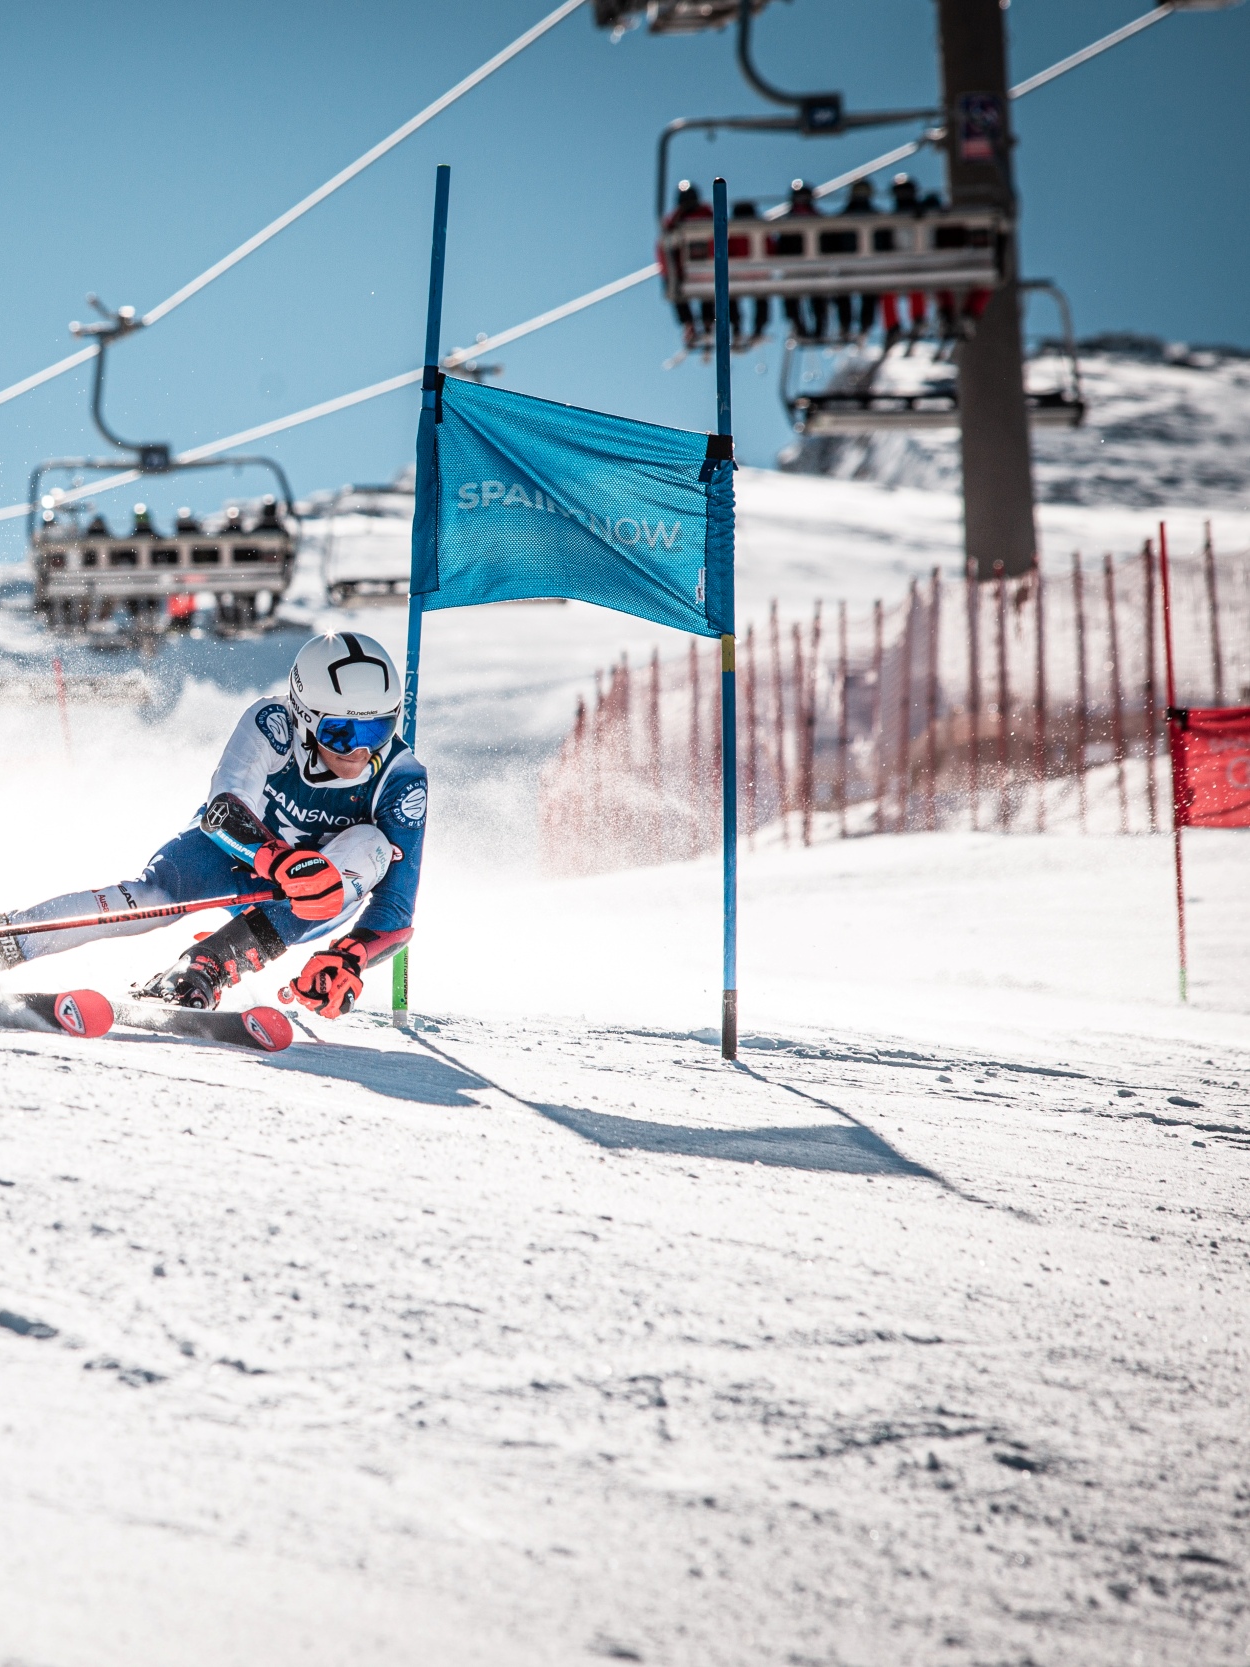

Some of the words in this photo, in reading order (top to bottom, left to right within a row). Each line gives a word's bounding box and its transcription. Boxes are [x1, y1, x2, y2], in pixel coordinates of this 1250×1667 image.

[457, 480, 682, 550] SPAINOW
[264, 783, 366, 826] PAINSNO
[393, 808, 406, 823] Club
[216, 830, 255, 859] ENERGIAPUR
[291, 858, 325, 875] reusch
[117, 884, 138, 910] EAD
